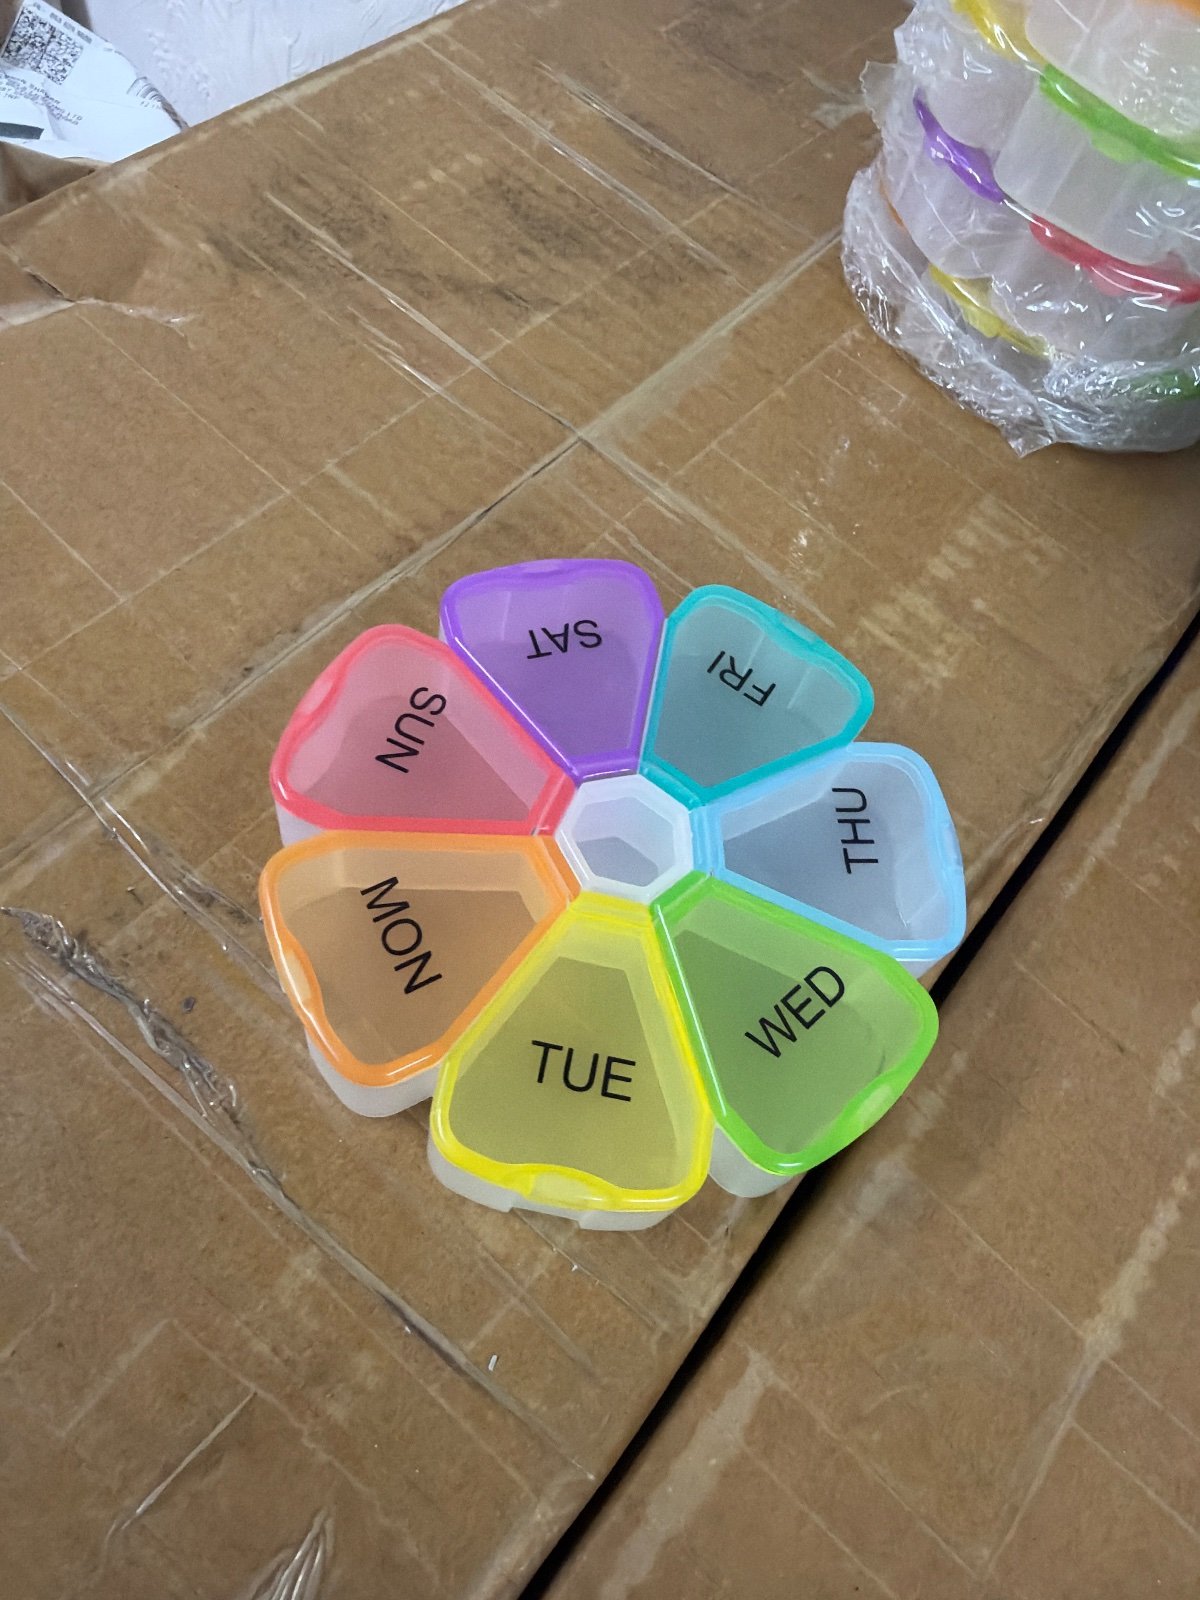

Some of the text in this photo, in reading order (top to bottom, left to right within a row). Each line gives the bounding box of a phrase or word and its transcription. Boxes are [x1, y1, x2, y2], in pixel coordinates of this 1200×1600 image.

[527, 620, 602, 659] SAT
[707, 651, 776, 706] FRI
[375, 687, 446, 773] SUN
[832, 788, 878, 874] THU
[361, 877, 442, 994] MON
[745, 967, 844, 1058] WED
[532, 1040, 635, 1101] TUE
